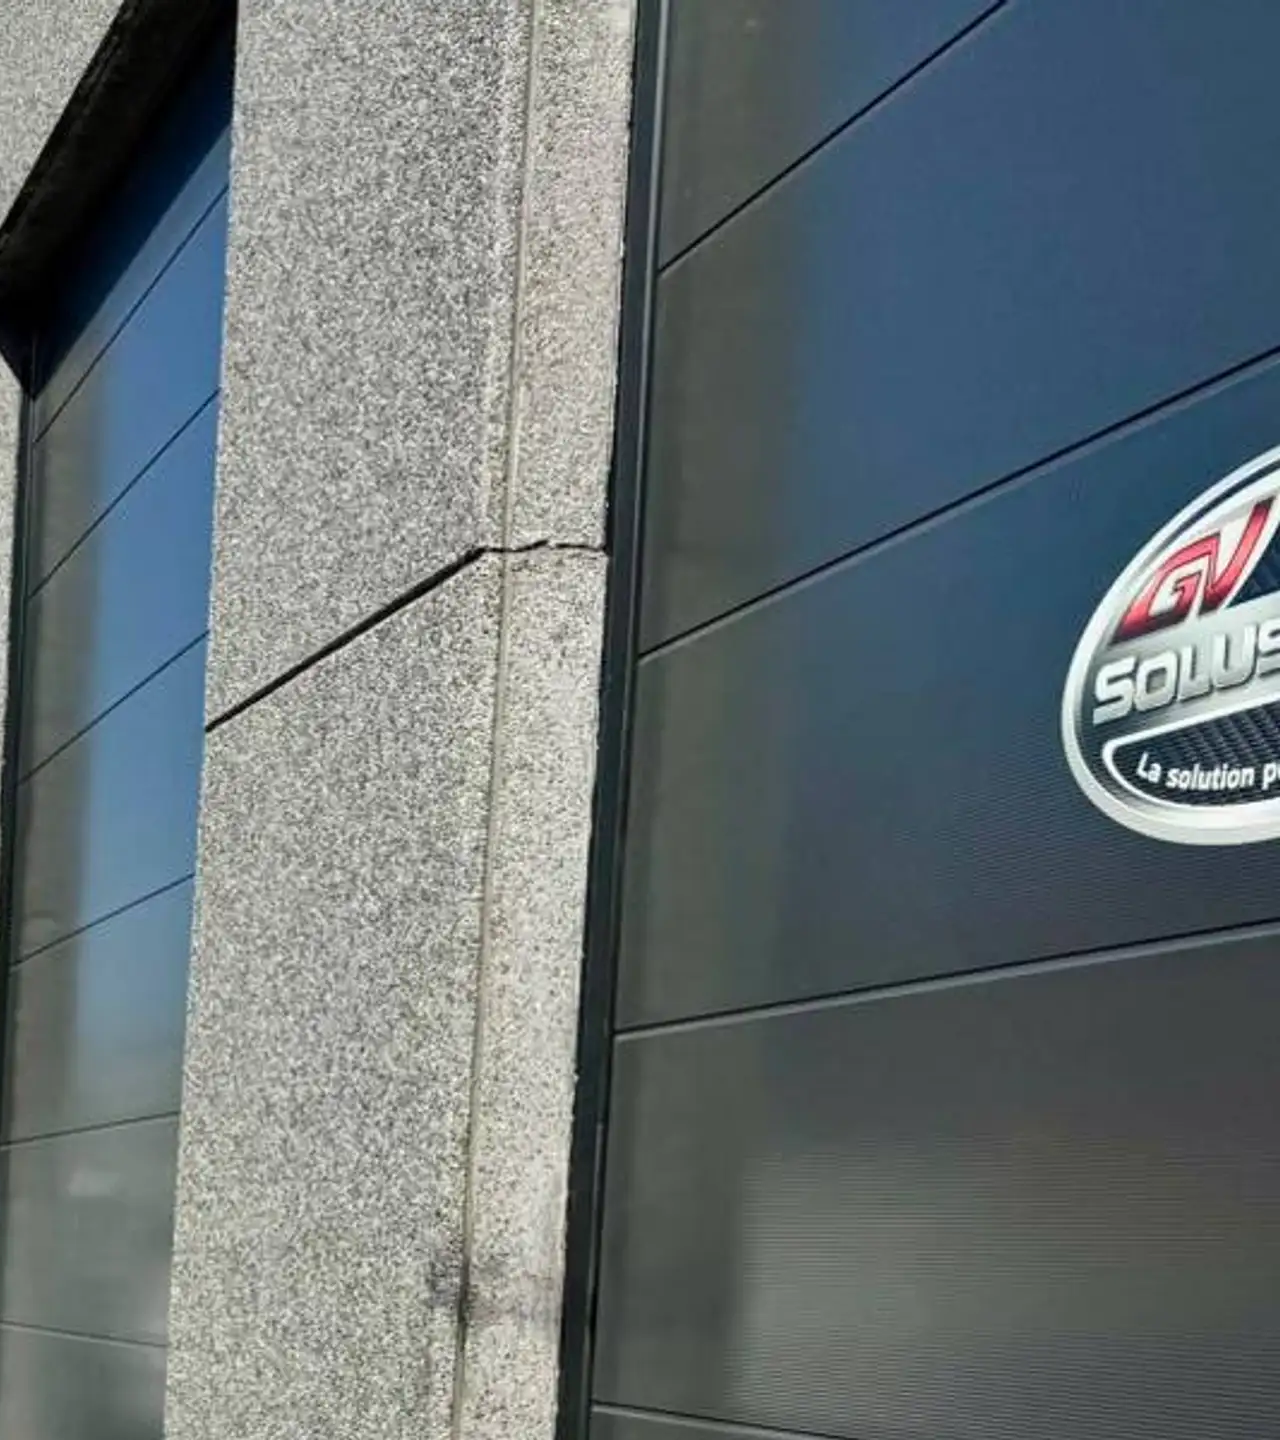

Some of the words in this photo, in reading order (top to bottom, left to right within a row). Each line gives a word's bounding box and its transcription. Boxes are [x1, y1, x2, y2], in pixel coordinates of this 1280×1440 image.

[1107, 496, 1276, 646] GV
[1136, 752, 1161, 783] La
[1165, 763, 1255, 791] solution
[1262, 762, 1280, 791] p
